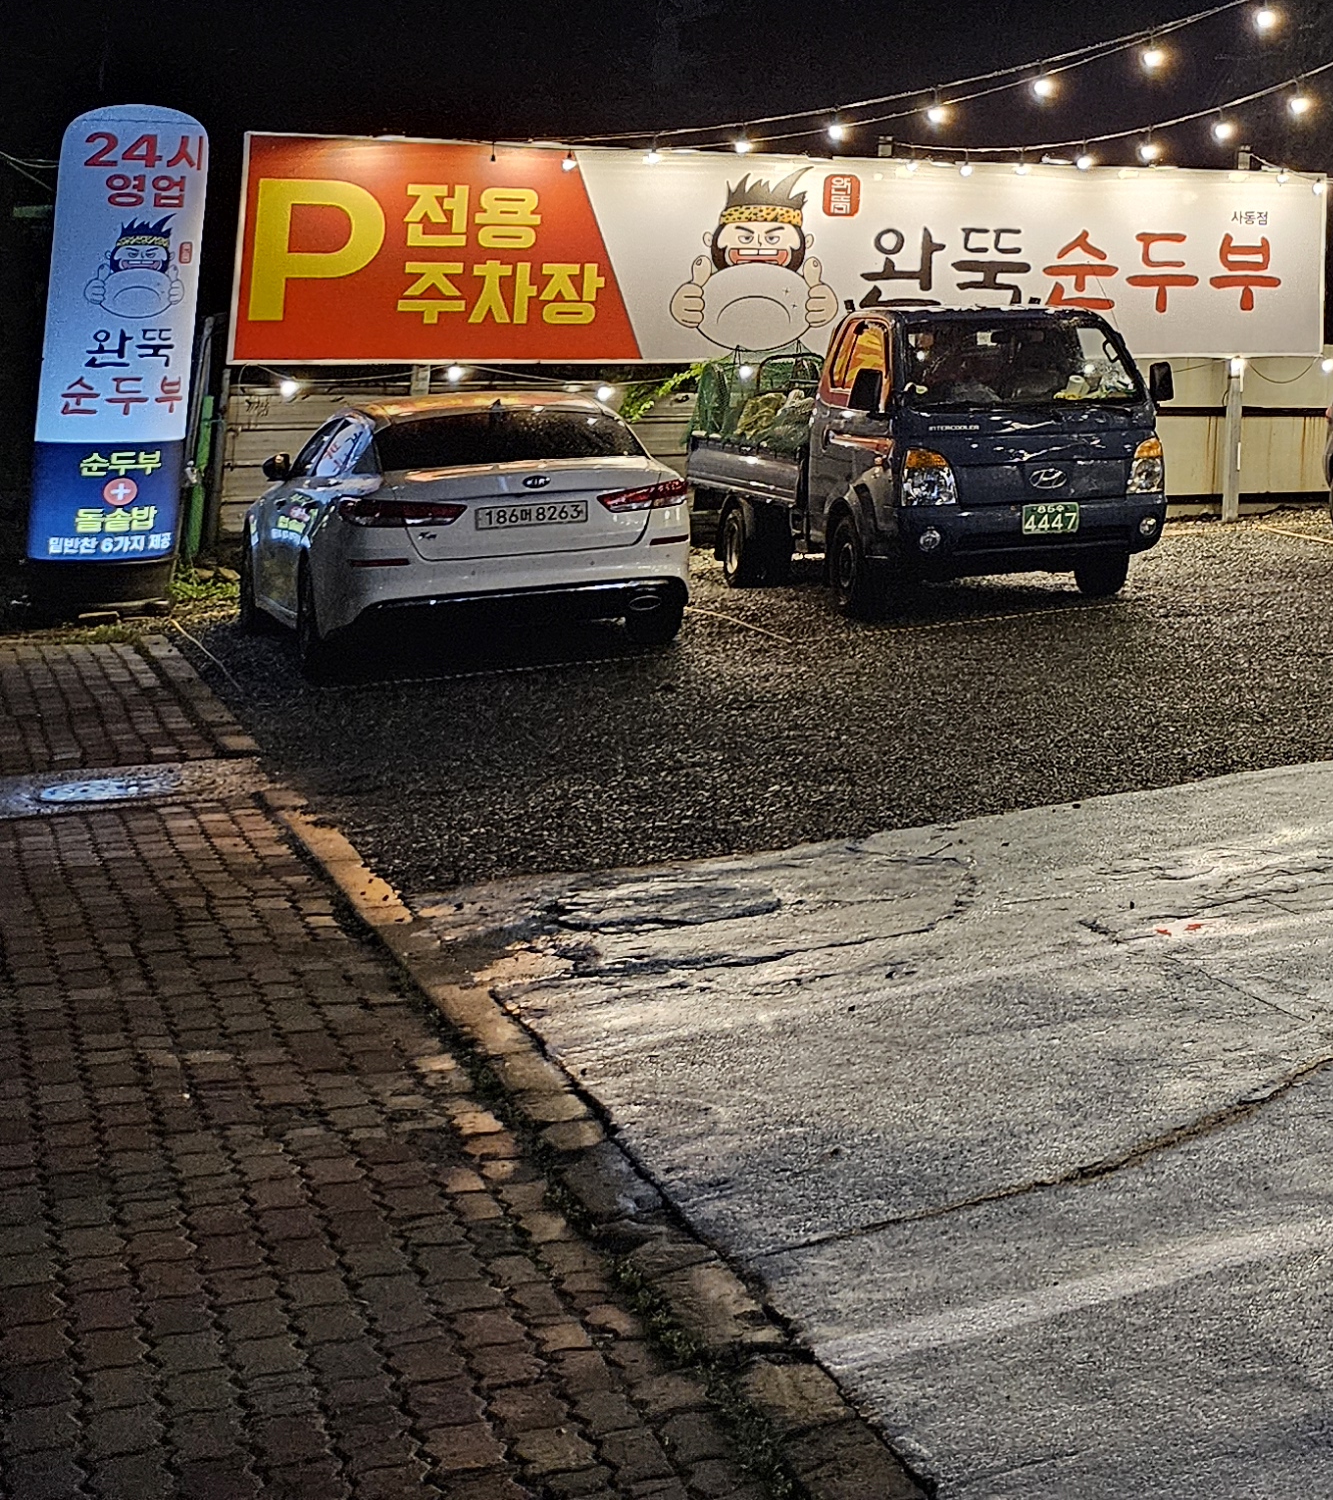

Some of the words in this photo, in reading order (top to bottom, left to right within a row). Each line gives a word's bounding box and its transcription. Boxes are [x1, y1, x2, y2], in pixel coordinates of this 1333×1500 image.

[84, 132, 204, 171] 24시
[105, 173, 187, 208] 영업
[403, 184, 542, 249] 전용
[1231, 211, 1269, 226] 사동점
[248, 179, 386, 322] P
[860, 226, 1282, 314] 완뚝순두부
[396, 262, 605, 325] 주차장
[84, 328, 175, 368] 완뚝
[61, 375, 183, 416] 순두부
[928, 424, 980, 432] INTERCOOLER
[79, 450, 162, 477] 순두부
[1024, 512, 1077, 532] 4447
[49, 535, 98, 554] 밑반찬
[100, 533, 145, 552] 6가지
[147, 531, 173, 549] 제공
